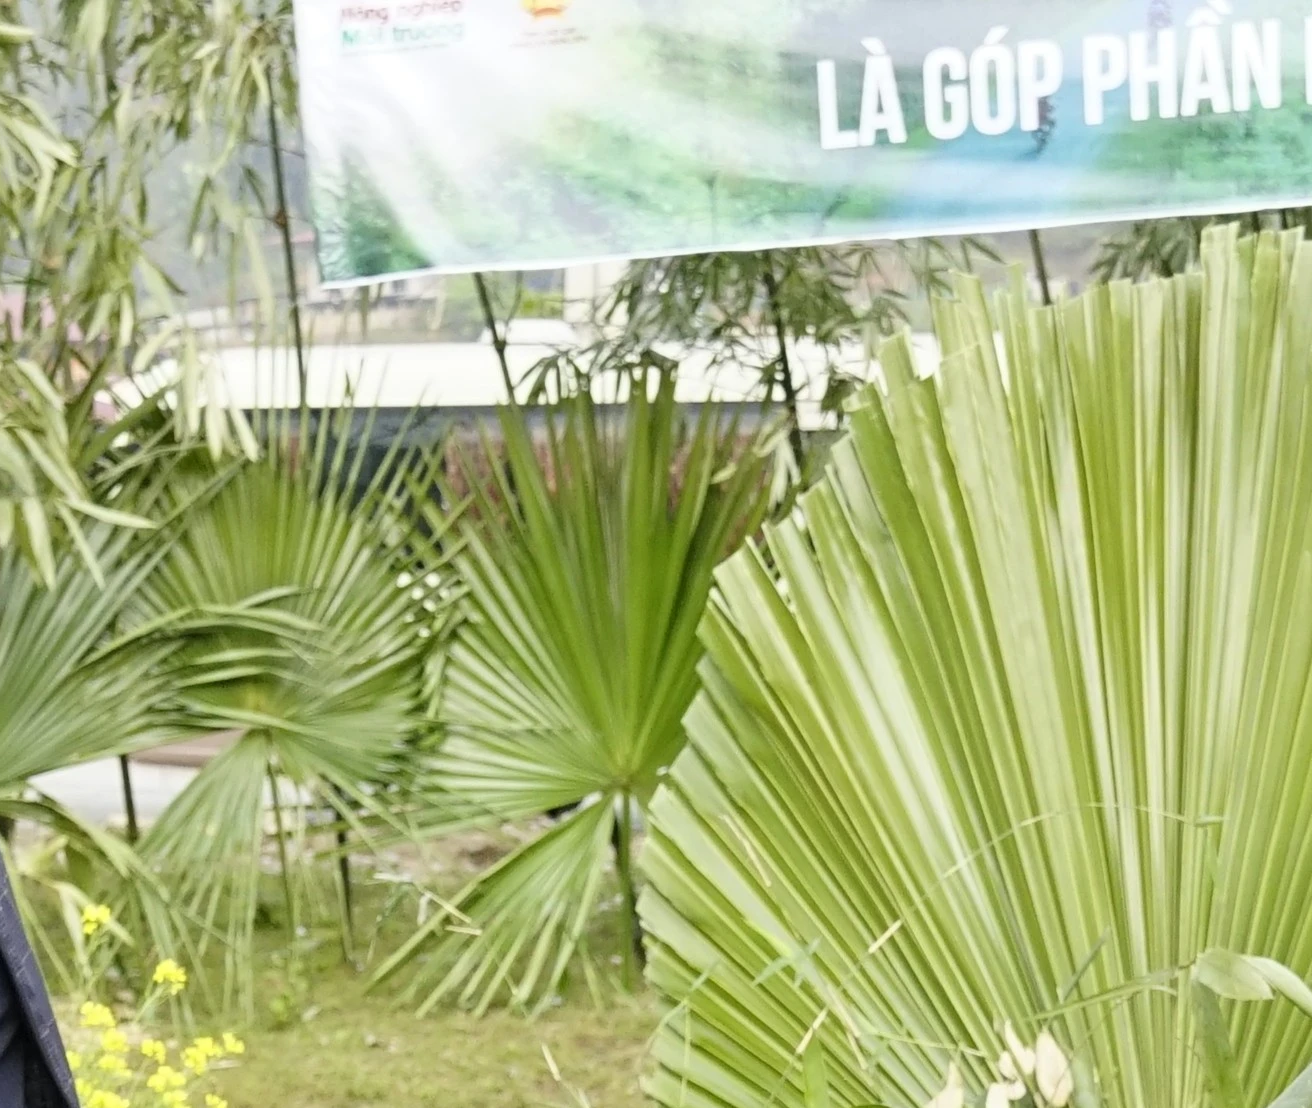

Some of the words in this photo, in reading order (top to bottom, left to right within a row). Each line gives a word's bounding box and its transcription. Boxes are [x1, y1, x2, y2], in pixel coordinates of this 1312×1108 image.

[816, 37, 908, 150] LÀ
[922, 26, 1064, 140] GÓP
[1082, 0, 1283, 126] PHẦN
